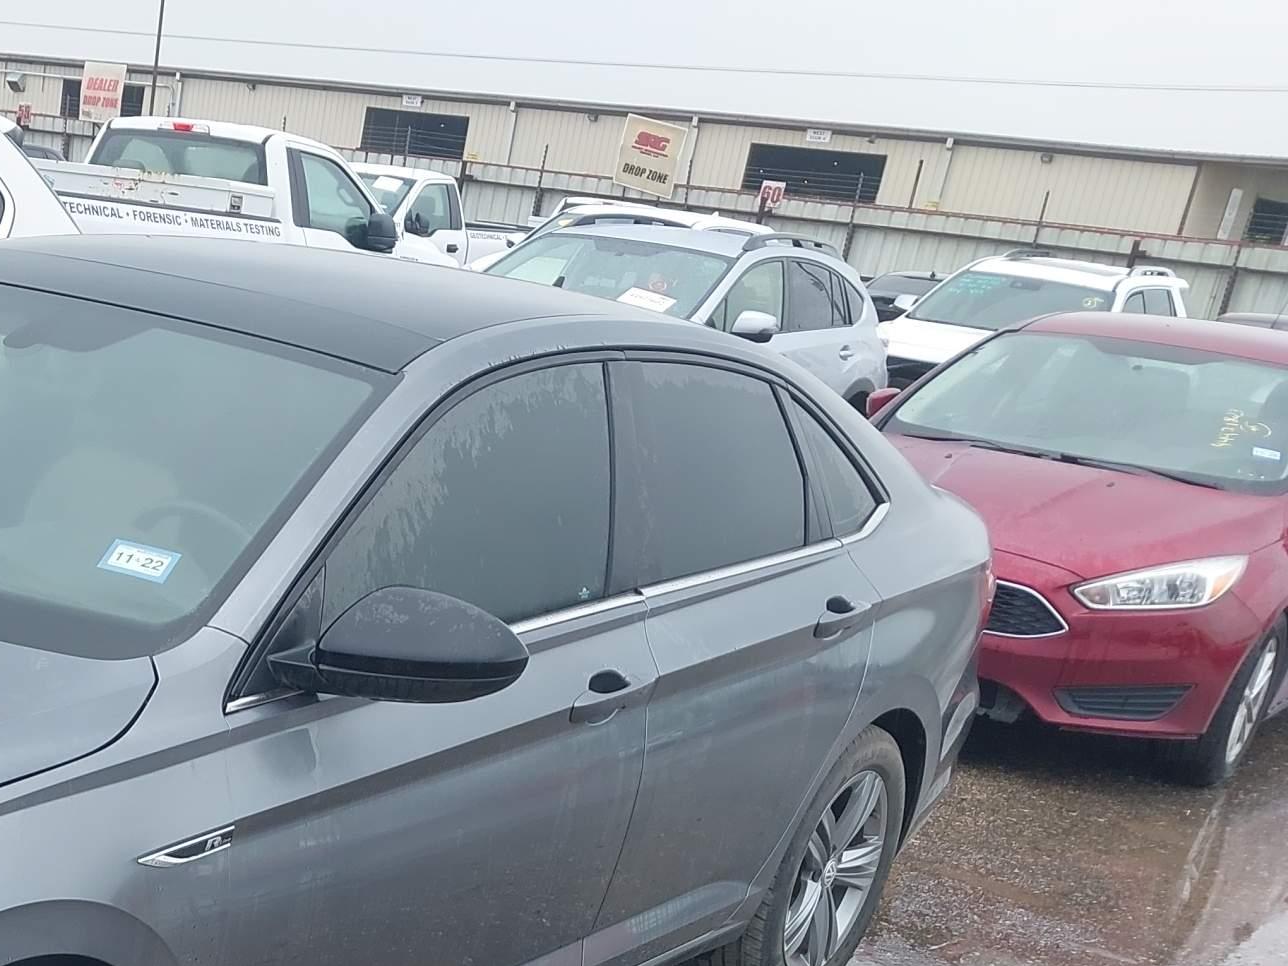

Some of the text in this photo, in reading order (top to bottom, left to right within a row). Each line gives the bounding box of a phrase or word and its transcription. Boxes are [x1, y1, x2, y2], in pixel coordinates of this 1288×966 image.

[86, 77, 120, 92] DEALER
[622, 162, 669, 185] DROP ZONE
[762, 185, 782, 204] 60
[133, 210, 182, 226] FORENSIC
[191, 217, 242, 233] MATERIALS
[244, 223, 281, 237] TESTING
